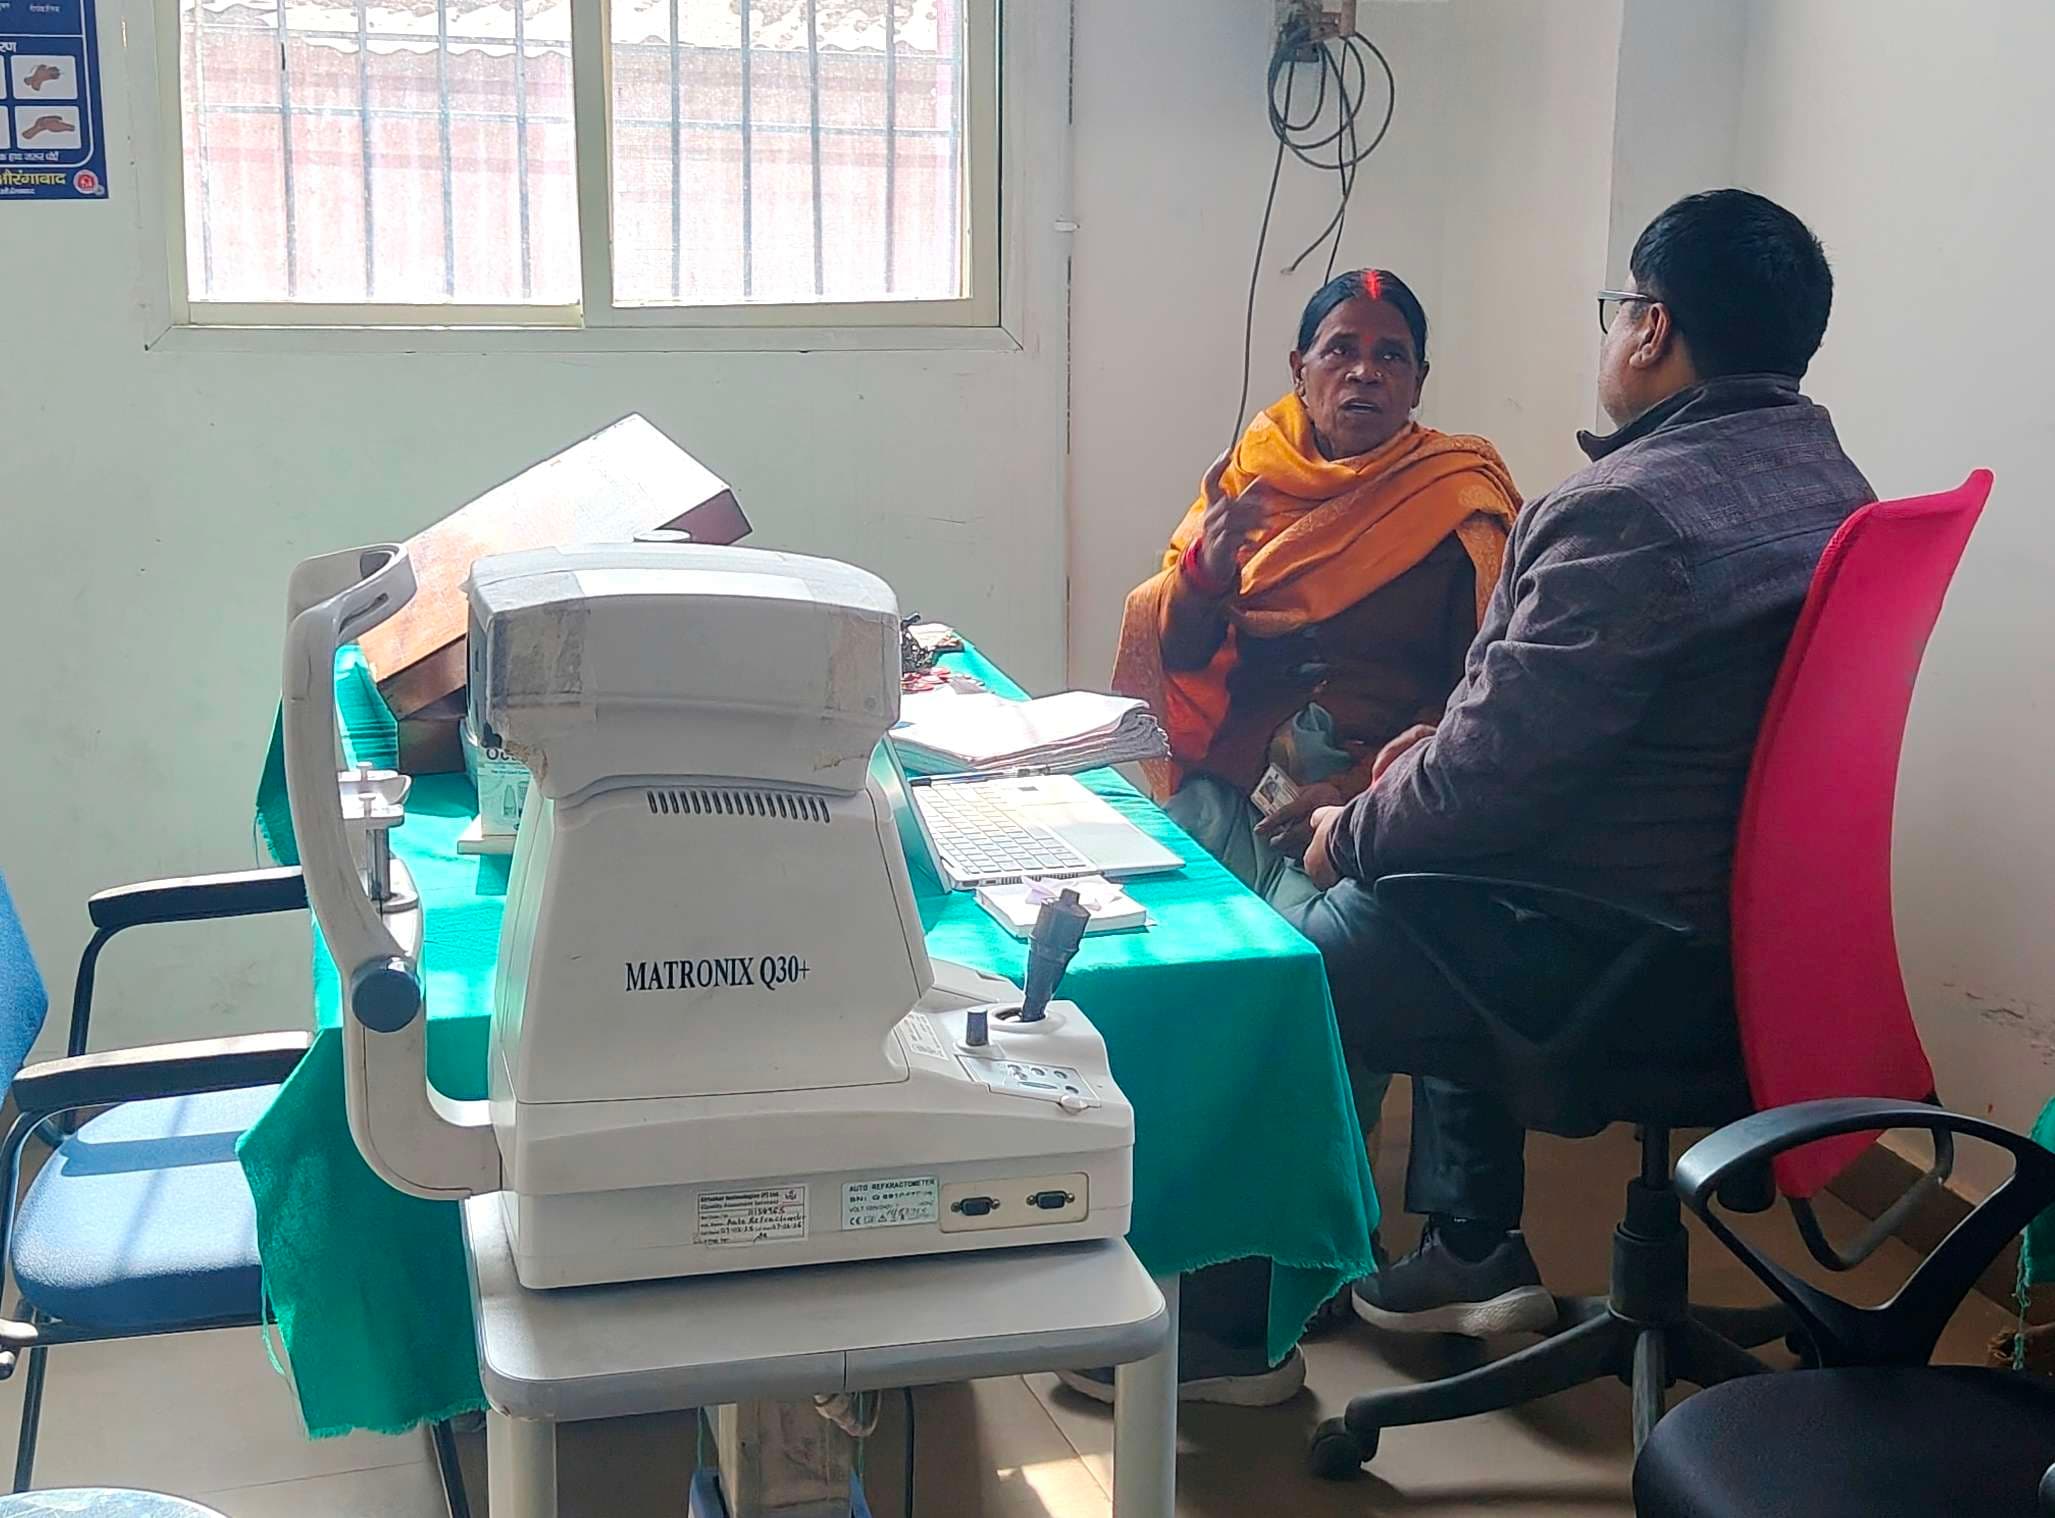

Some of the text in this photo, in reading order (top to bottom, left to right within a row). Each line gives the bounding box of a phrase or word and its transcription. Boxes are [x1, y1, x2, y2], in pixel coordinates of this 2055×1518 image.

[625, 955, 810, 992] MATRONIX Q30+
[849, 1183, 868, 1192] AUTO
